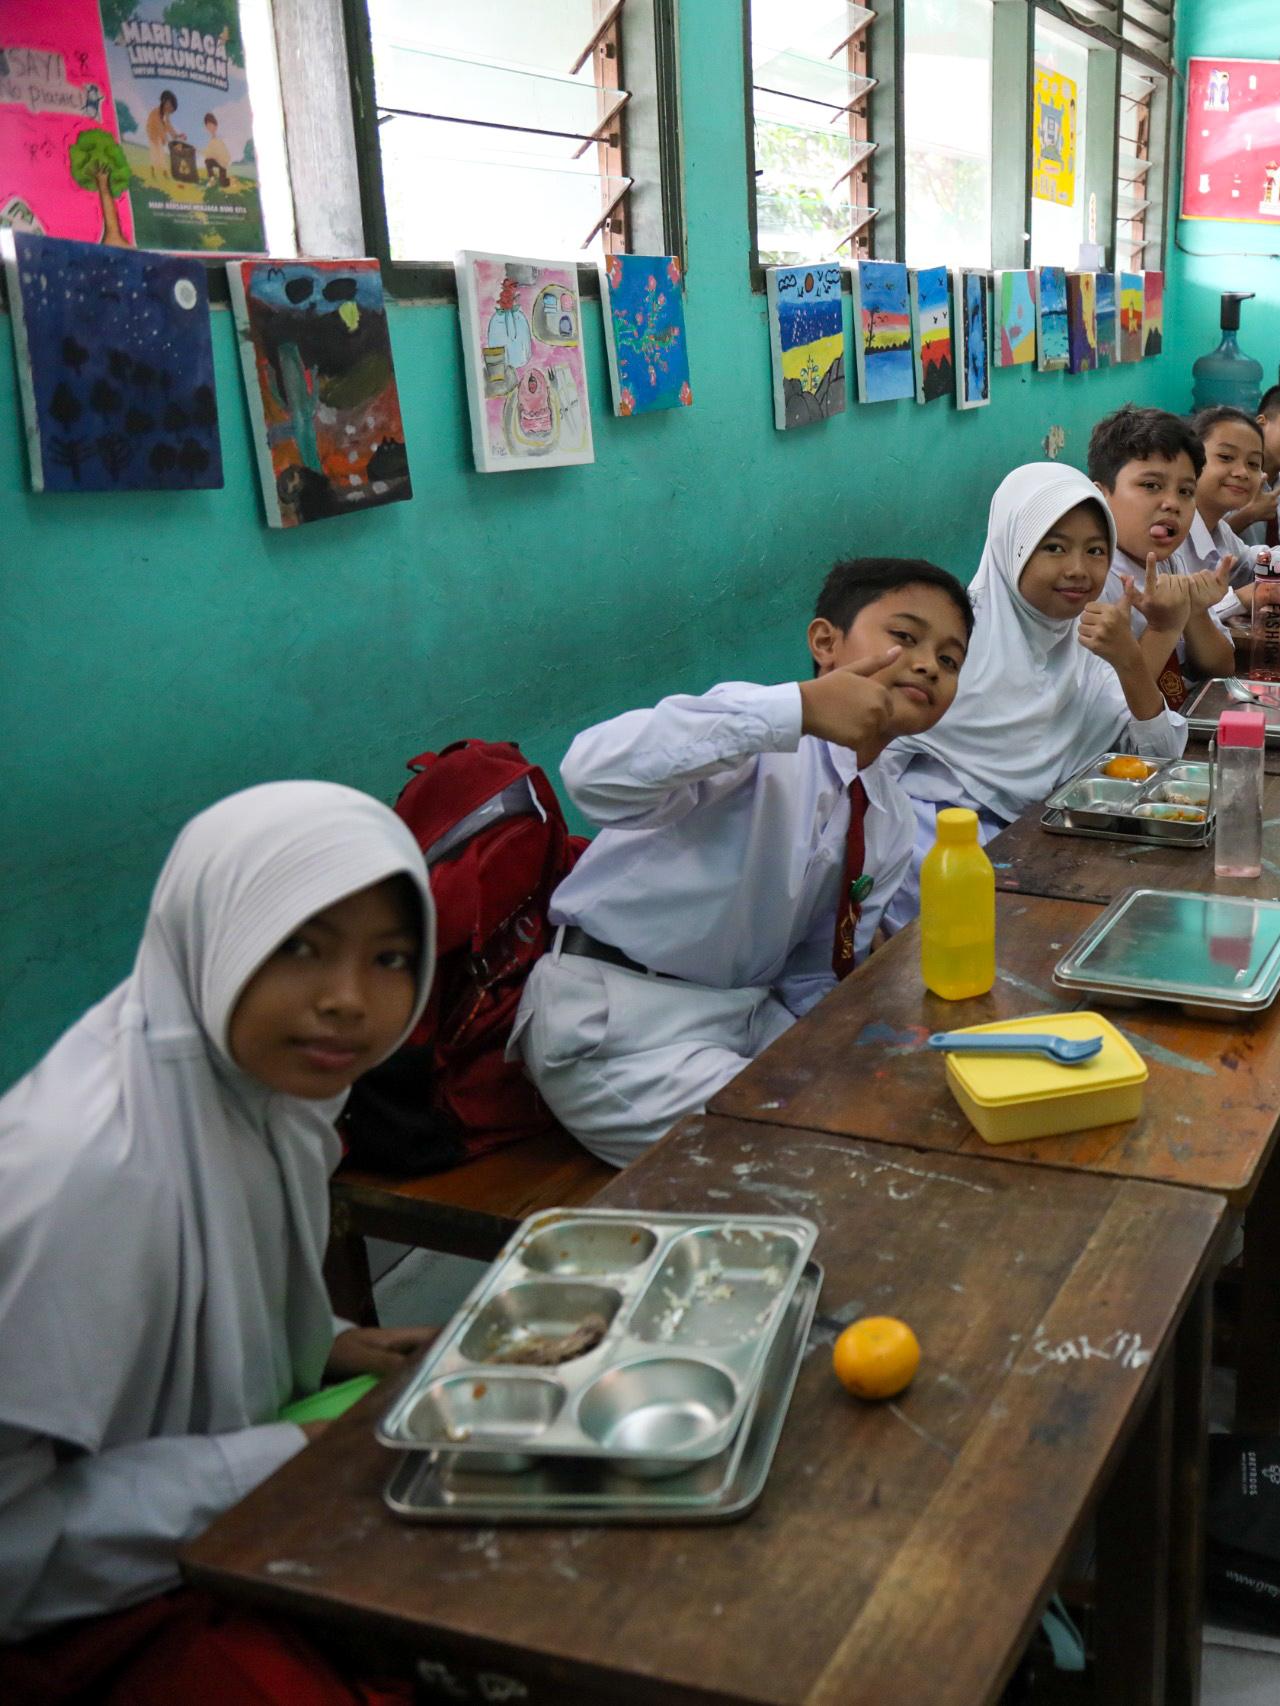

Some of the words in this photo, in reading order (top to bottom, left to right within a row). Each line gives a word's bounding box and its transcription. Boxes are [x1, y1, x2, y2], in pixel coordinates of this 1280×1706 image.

[121, 21, 172, 46] MARI
[179, 27, 227, 60] JAGA
[128, 45, 227, 80] LINGKUNGAN
